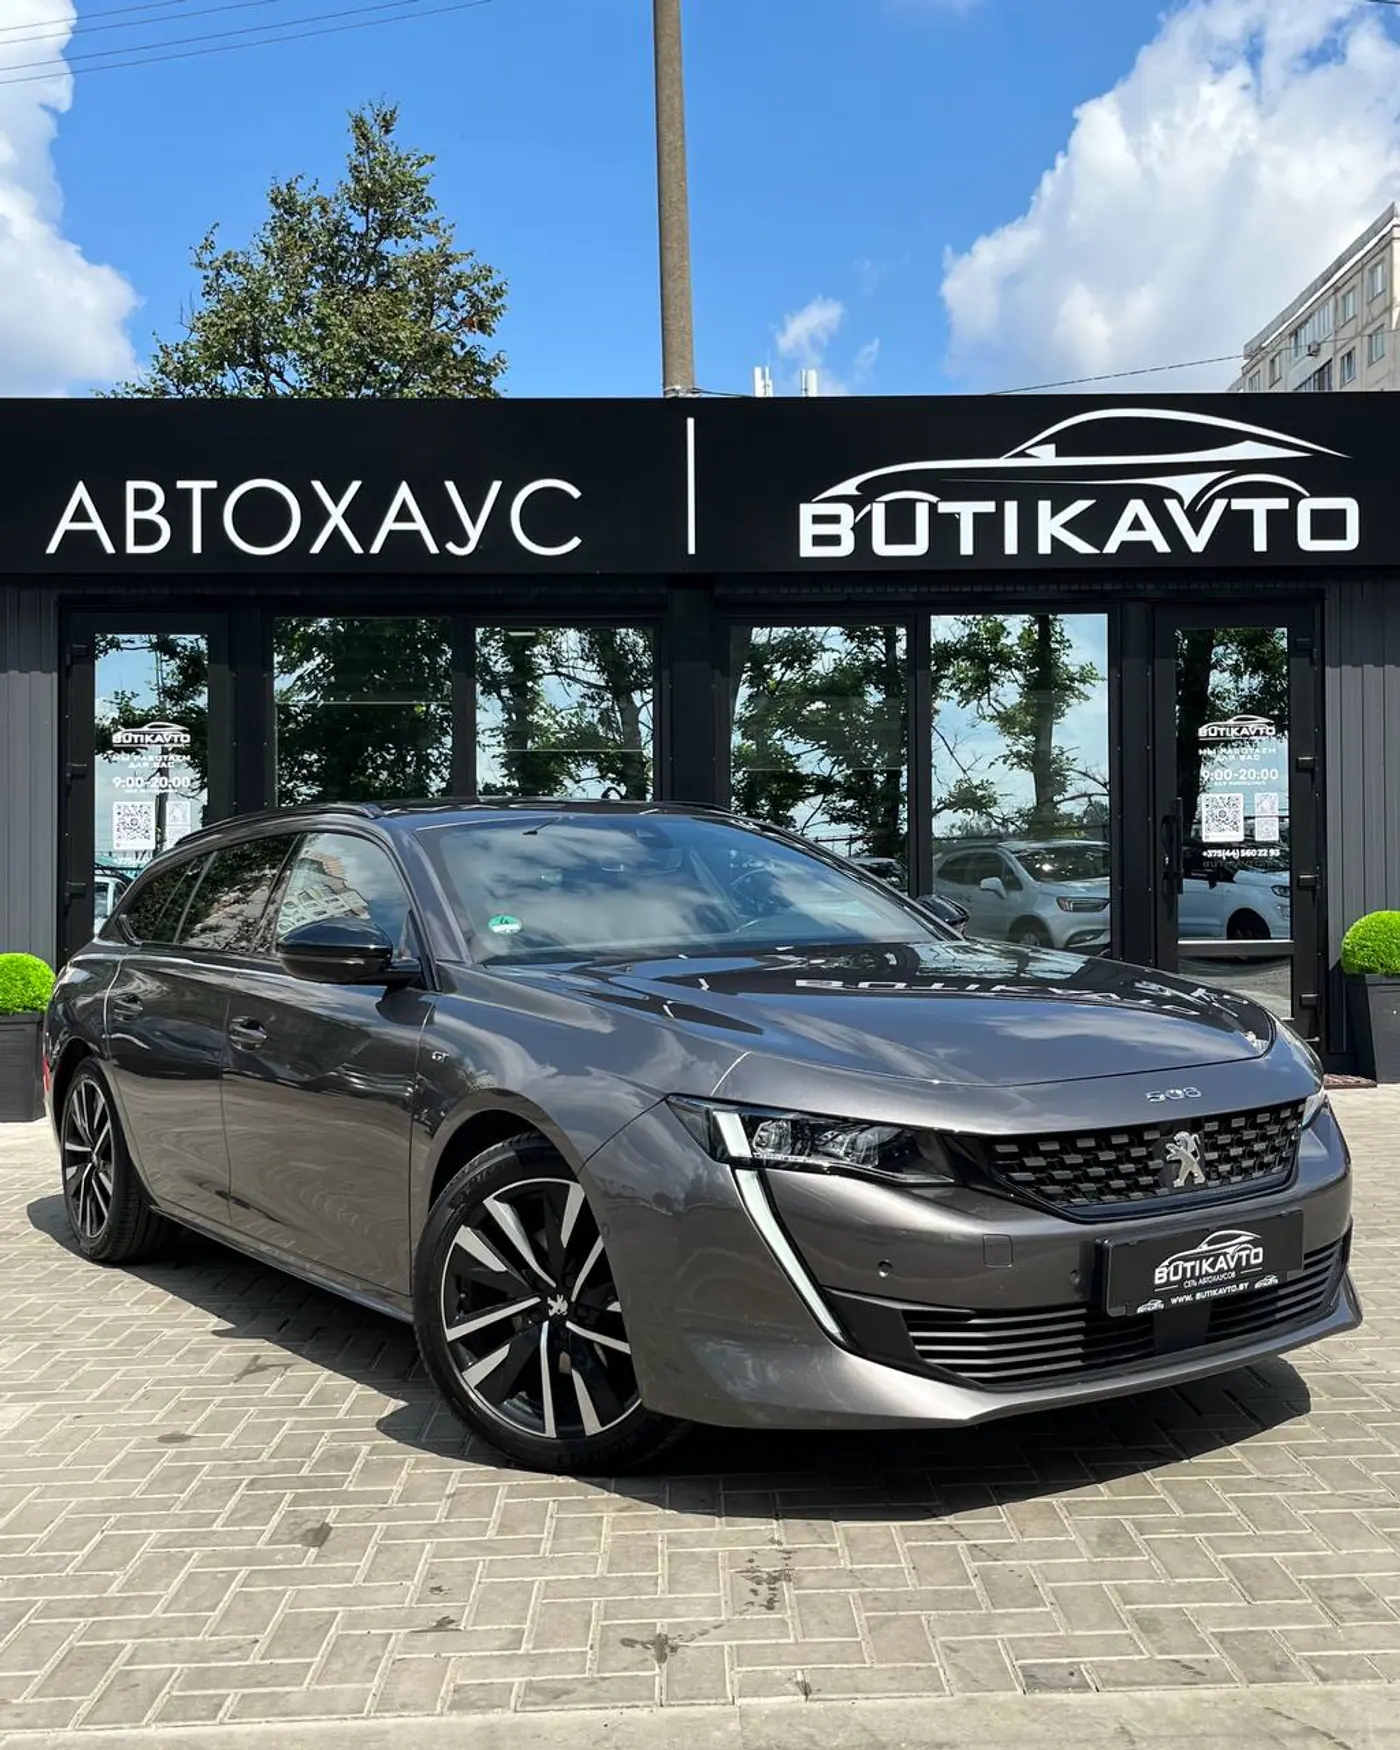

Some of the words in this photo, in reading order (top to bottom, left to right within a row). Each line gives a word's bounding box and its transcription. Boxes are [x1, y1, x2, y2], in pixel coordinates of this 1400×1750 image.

[45, 478, 583, 556] АВТОХАУС
[798, 494, 1360, 558] BUTIKAVTO
[112, 732, 191, 744] BUTIKAVTO
[1198, 727, 1276, 737] BUTIKAVTO
[1202, 768, 1278, 781] 9:00-20:00
[112, 776, 191, 788] 9:00-20:00
[431, 1051, 450, 1062] GT
[1145, 1087, 1202, 1102] 508
[1154, 1246, 1264, 1285] BUTIKAVTO
